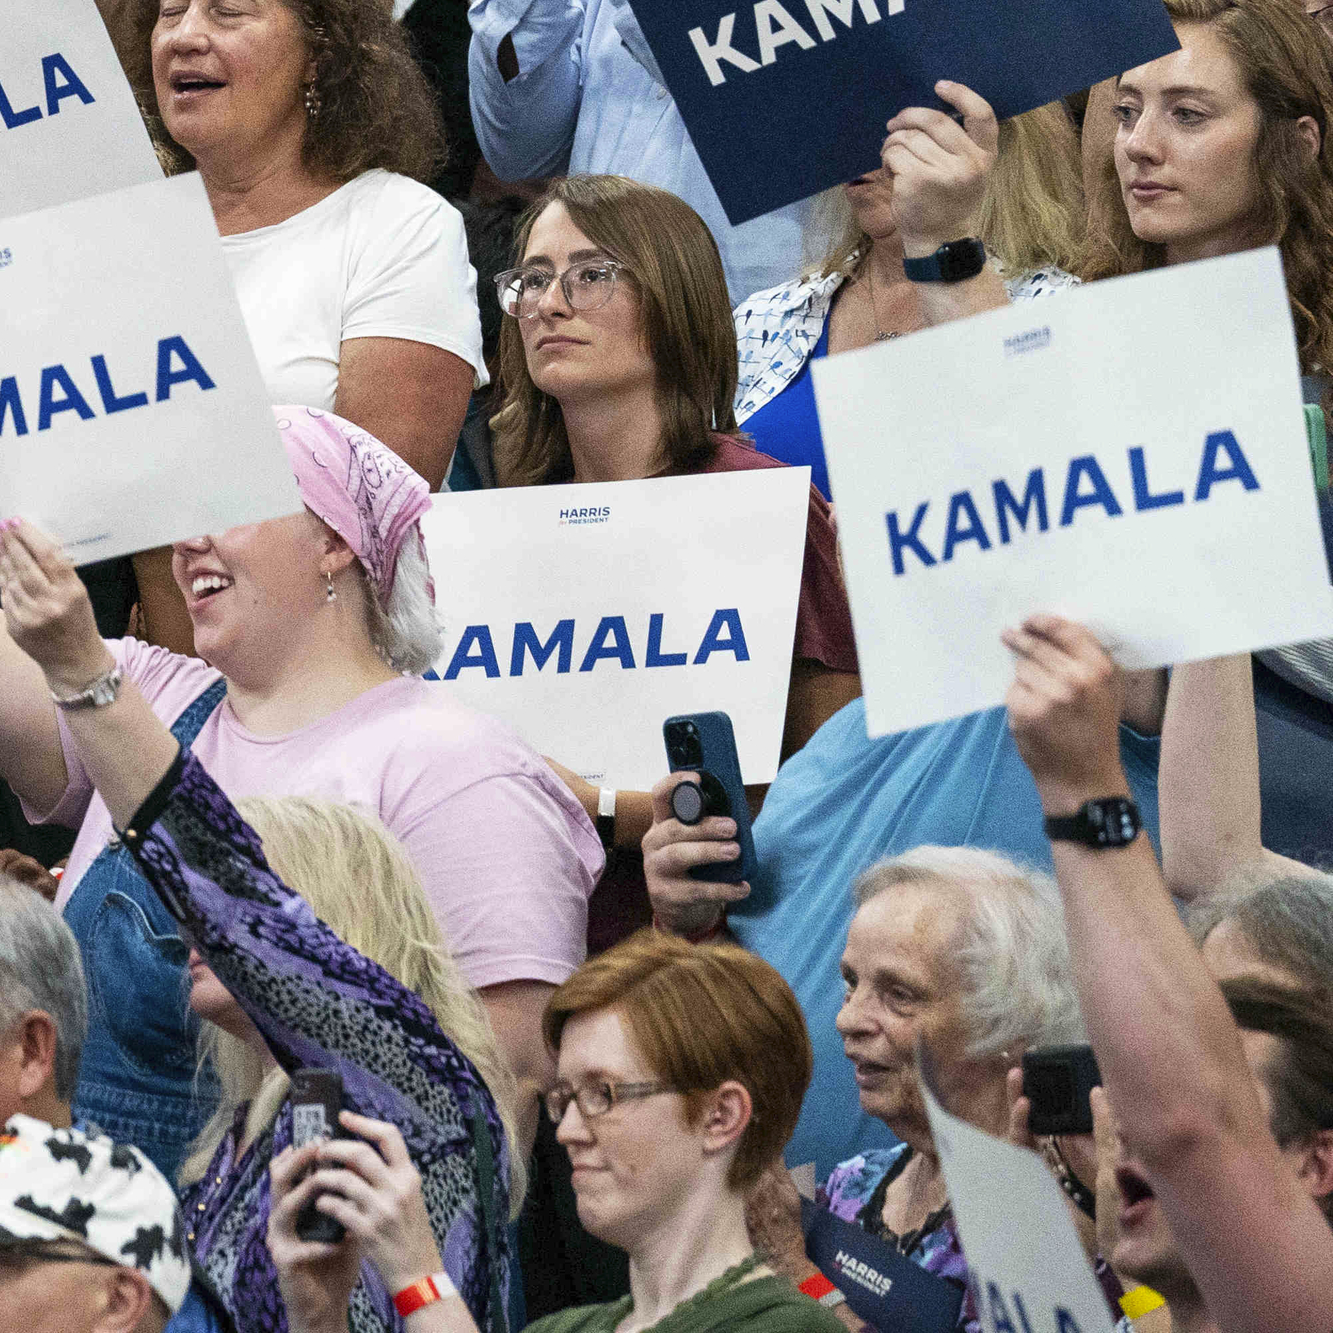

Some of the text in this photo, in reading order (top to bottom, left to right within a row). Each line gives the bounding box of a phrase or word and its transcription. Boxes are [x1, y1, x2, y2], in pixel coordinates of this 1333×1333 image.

[559, 507, 610, 519] HARRIS
[569, 517, 608, 525] PRESIDENT
[885, 429, 1261, 576] KAMALA
[423, 608, 750, 682] AMALA
[835, 1249, 892, 1291] HARRIS
